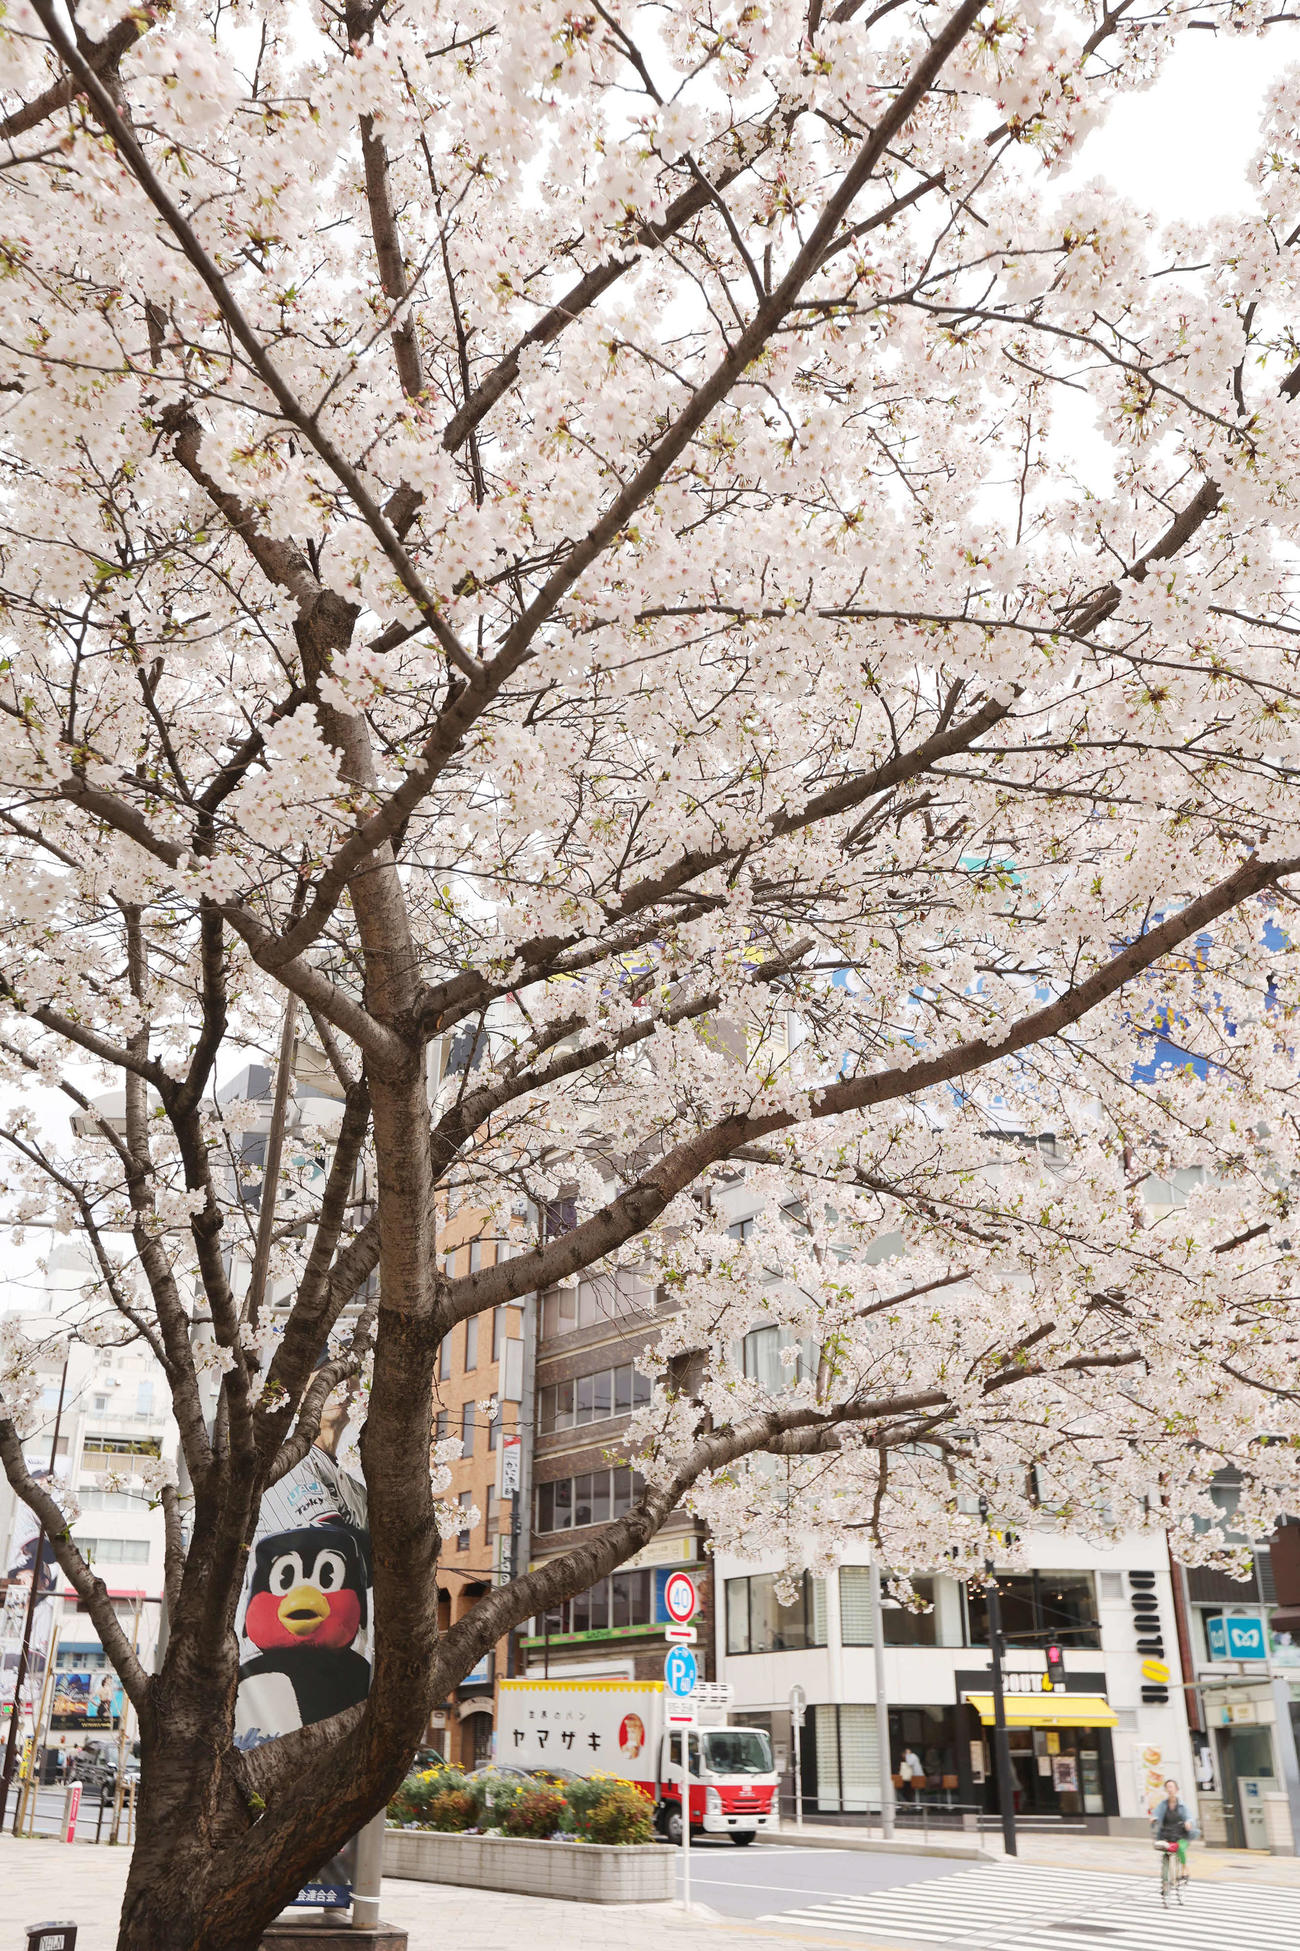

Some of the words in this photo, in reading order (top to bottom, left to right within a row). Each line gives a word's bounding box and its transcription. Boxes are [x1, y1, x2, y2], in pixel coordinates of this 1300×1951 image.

[673, 1587, 689, 1609] 40
[1129, 1570, 1170, 1703] DOUTOR
[671, 1659, 685, 1691] P
[512, 1729, 601, 1751] ヤマザキ
